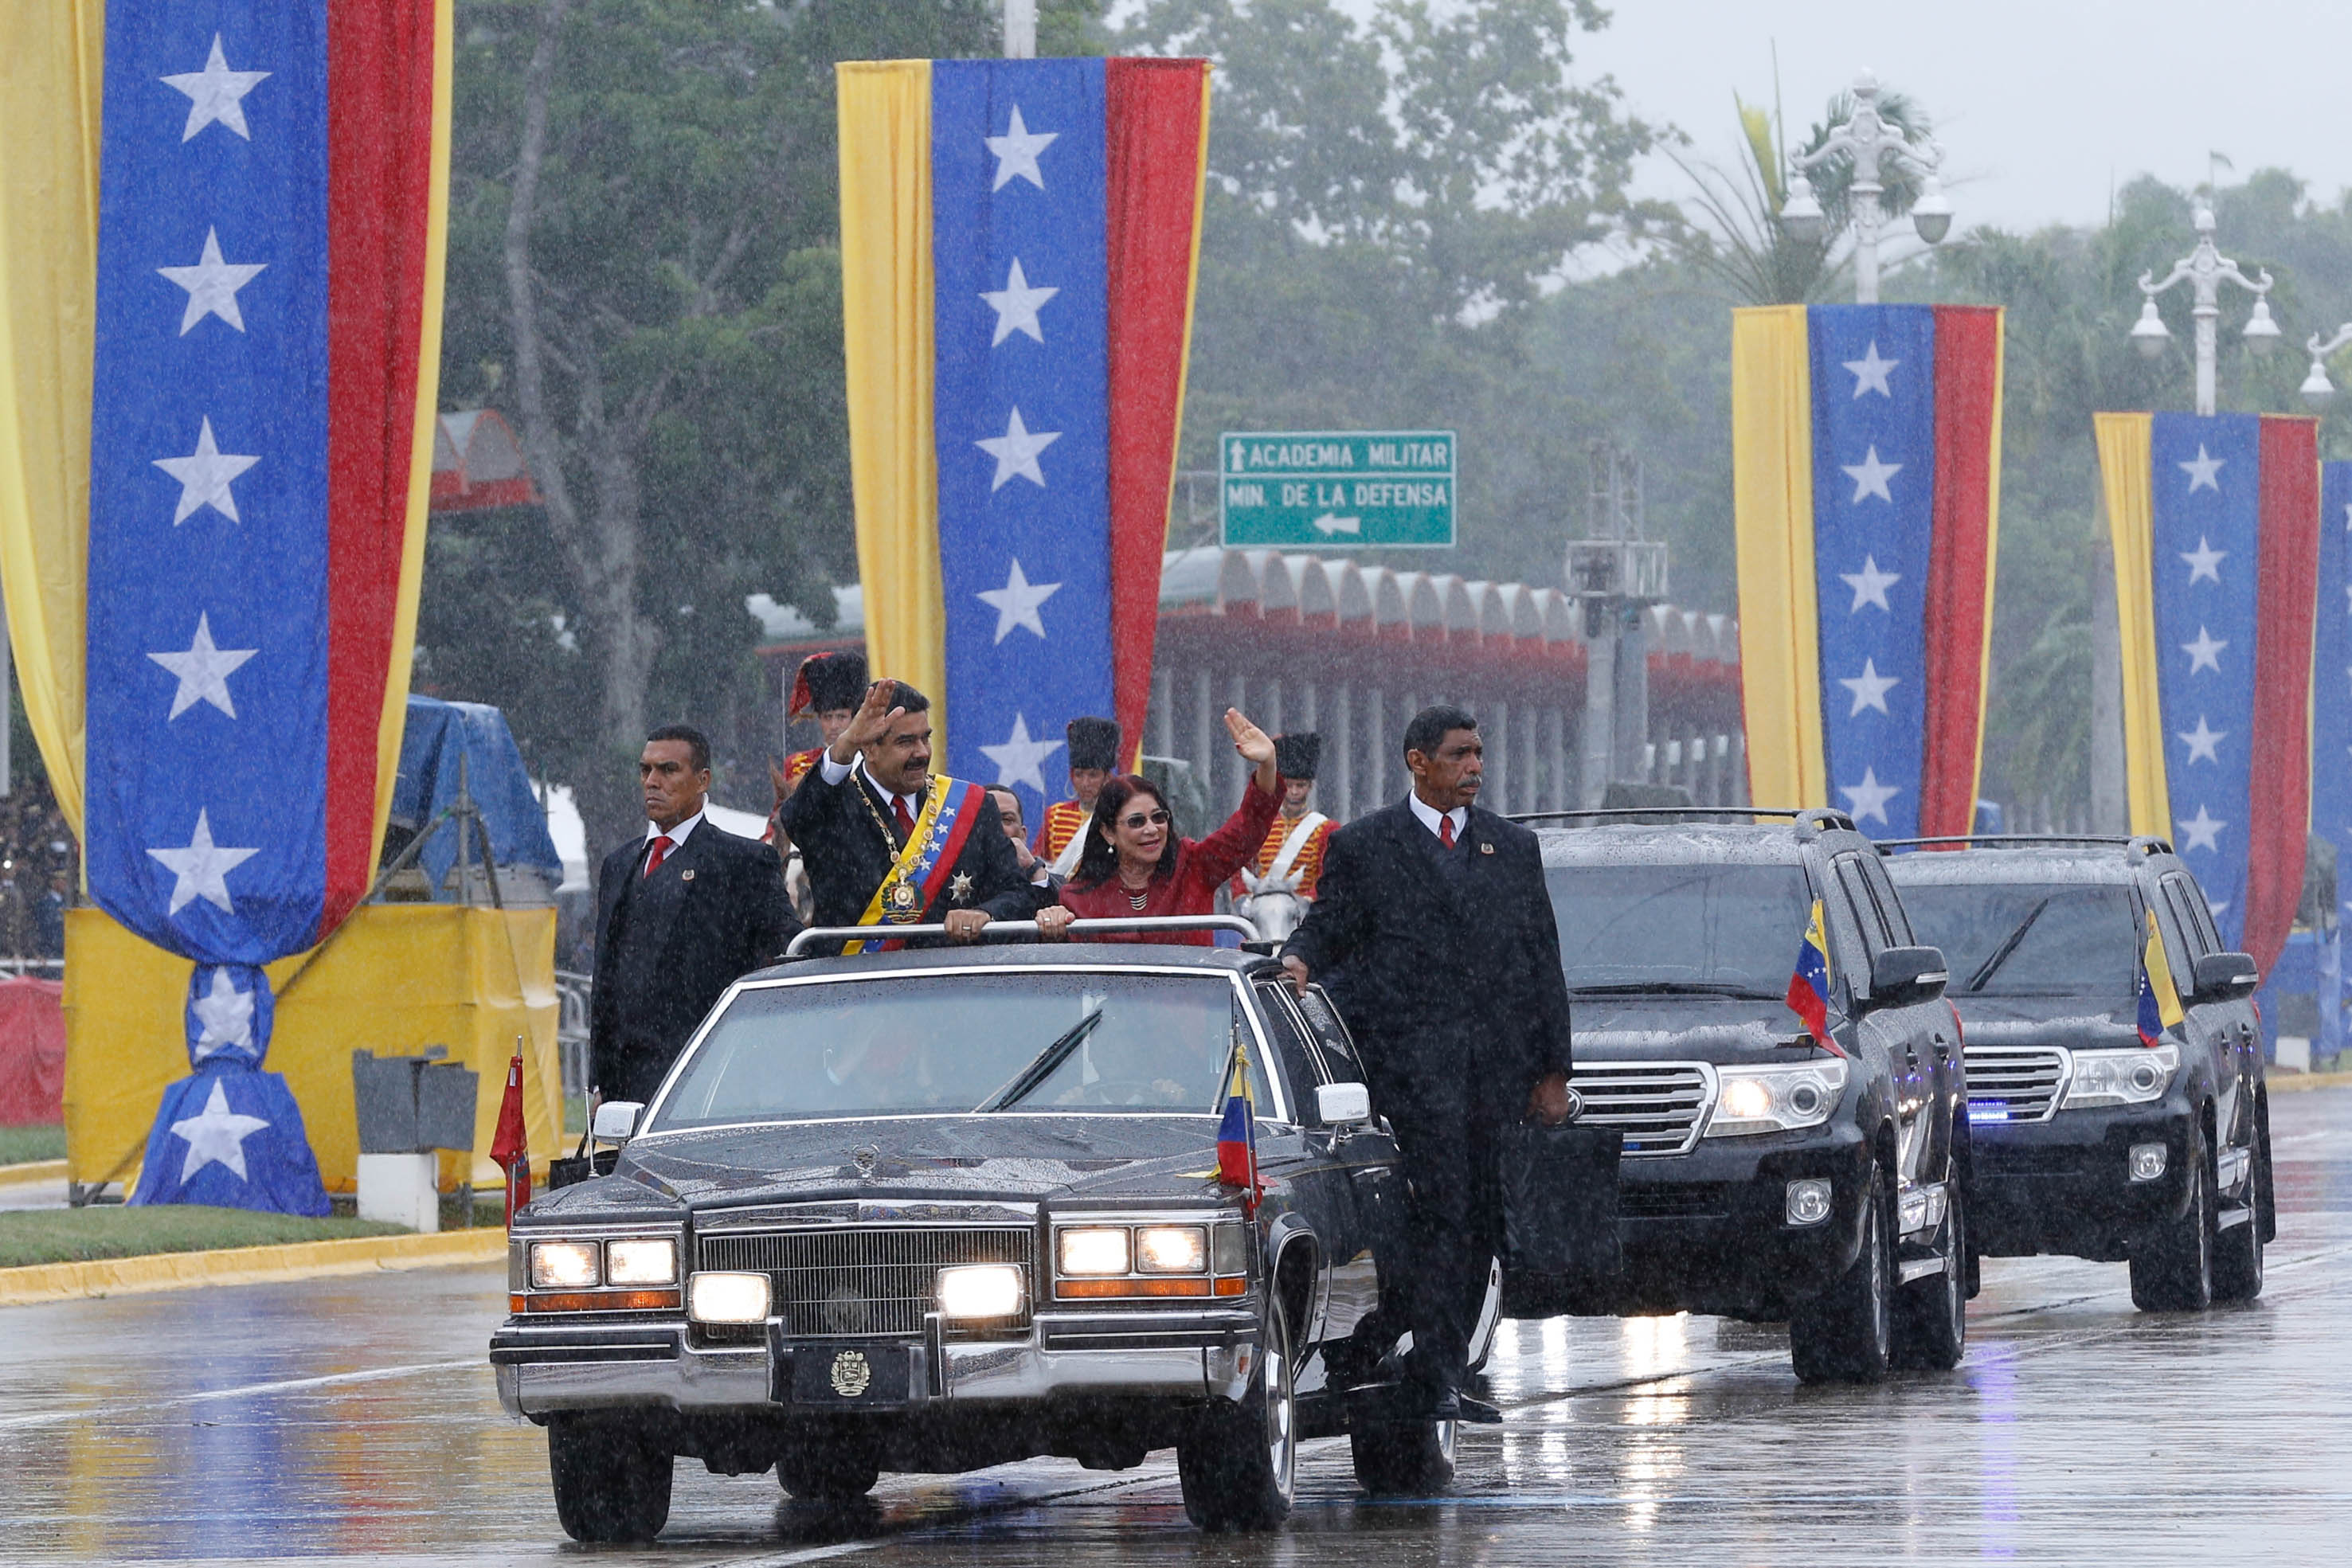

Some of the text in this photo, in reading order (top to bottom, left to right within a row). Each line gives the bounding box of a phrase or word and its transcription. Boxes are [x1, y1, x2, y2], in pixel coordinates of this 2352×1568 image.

[1250, 443, 1447, 467] ACADEMIA MILITAR
[1282, 483, 1309, 506] DE
[1317, 483, 1346, 507] LA
[1356, 483, 1447, 507] DEFENSA
